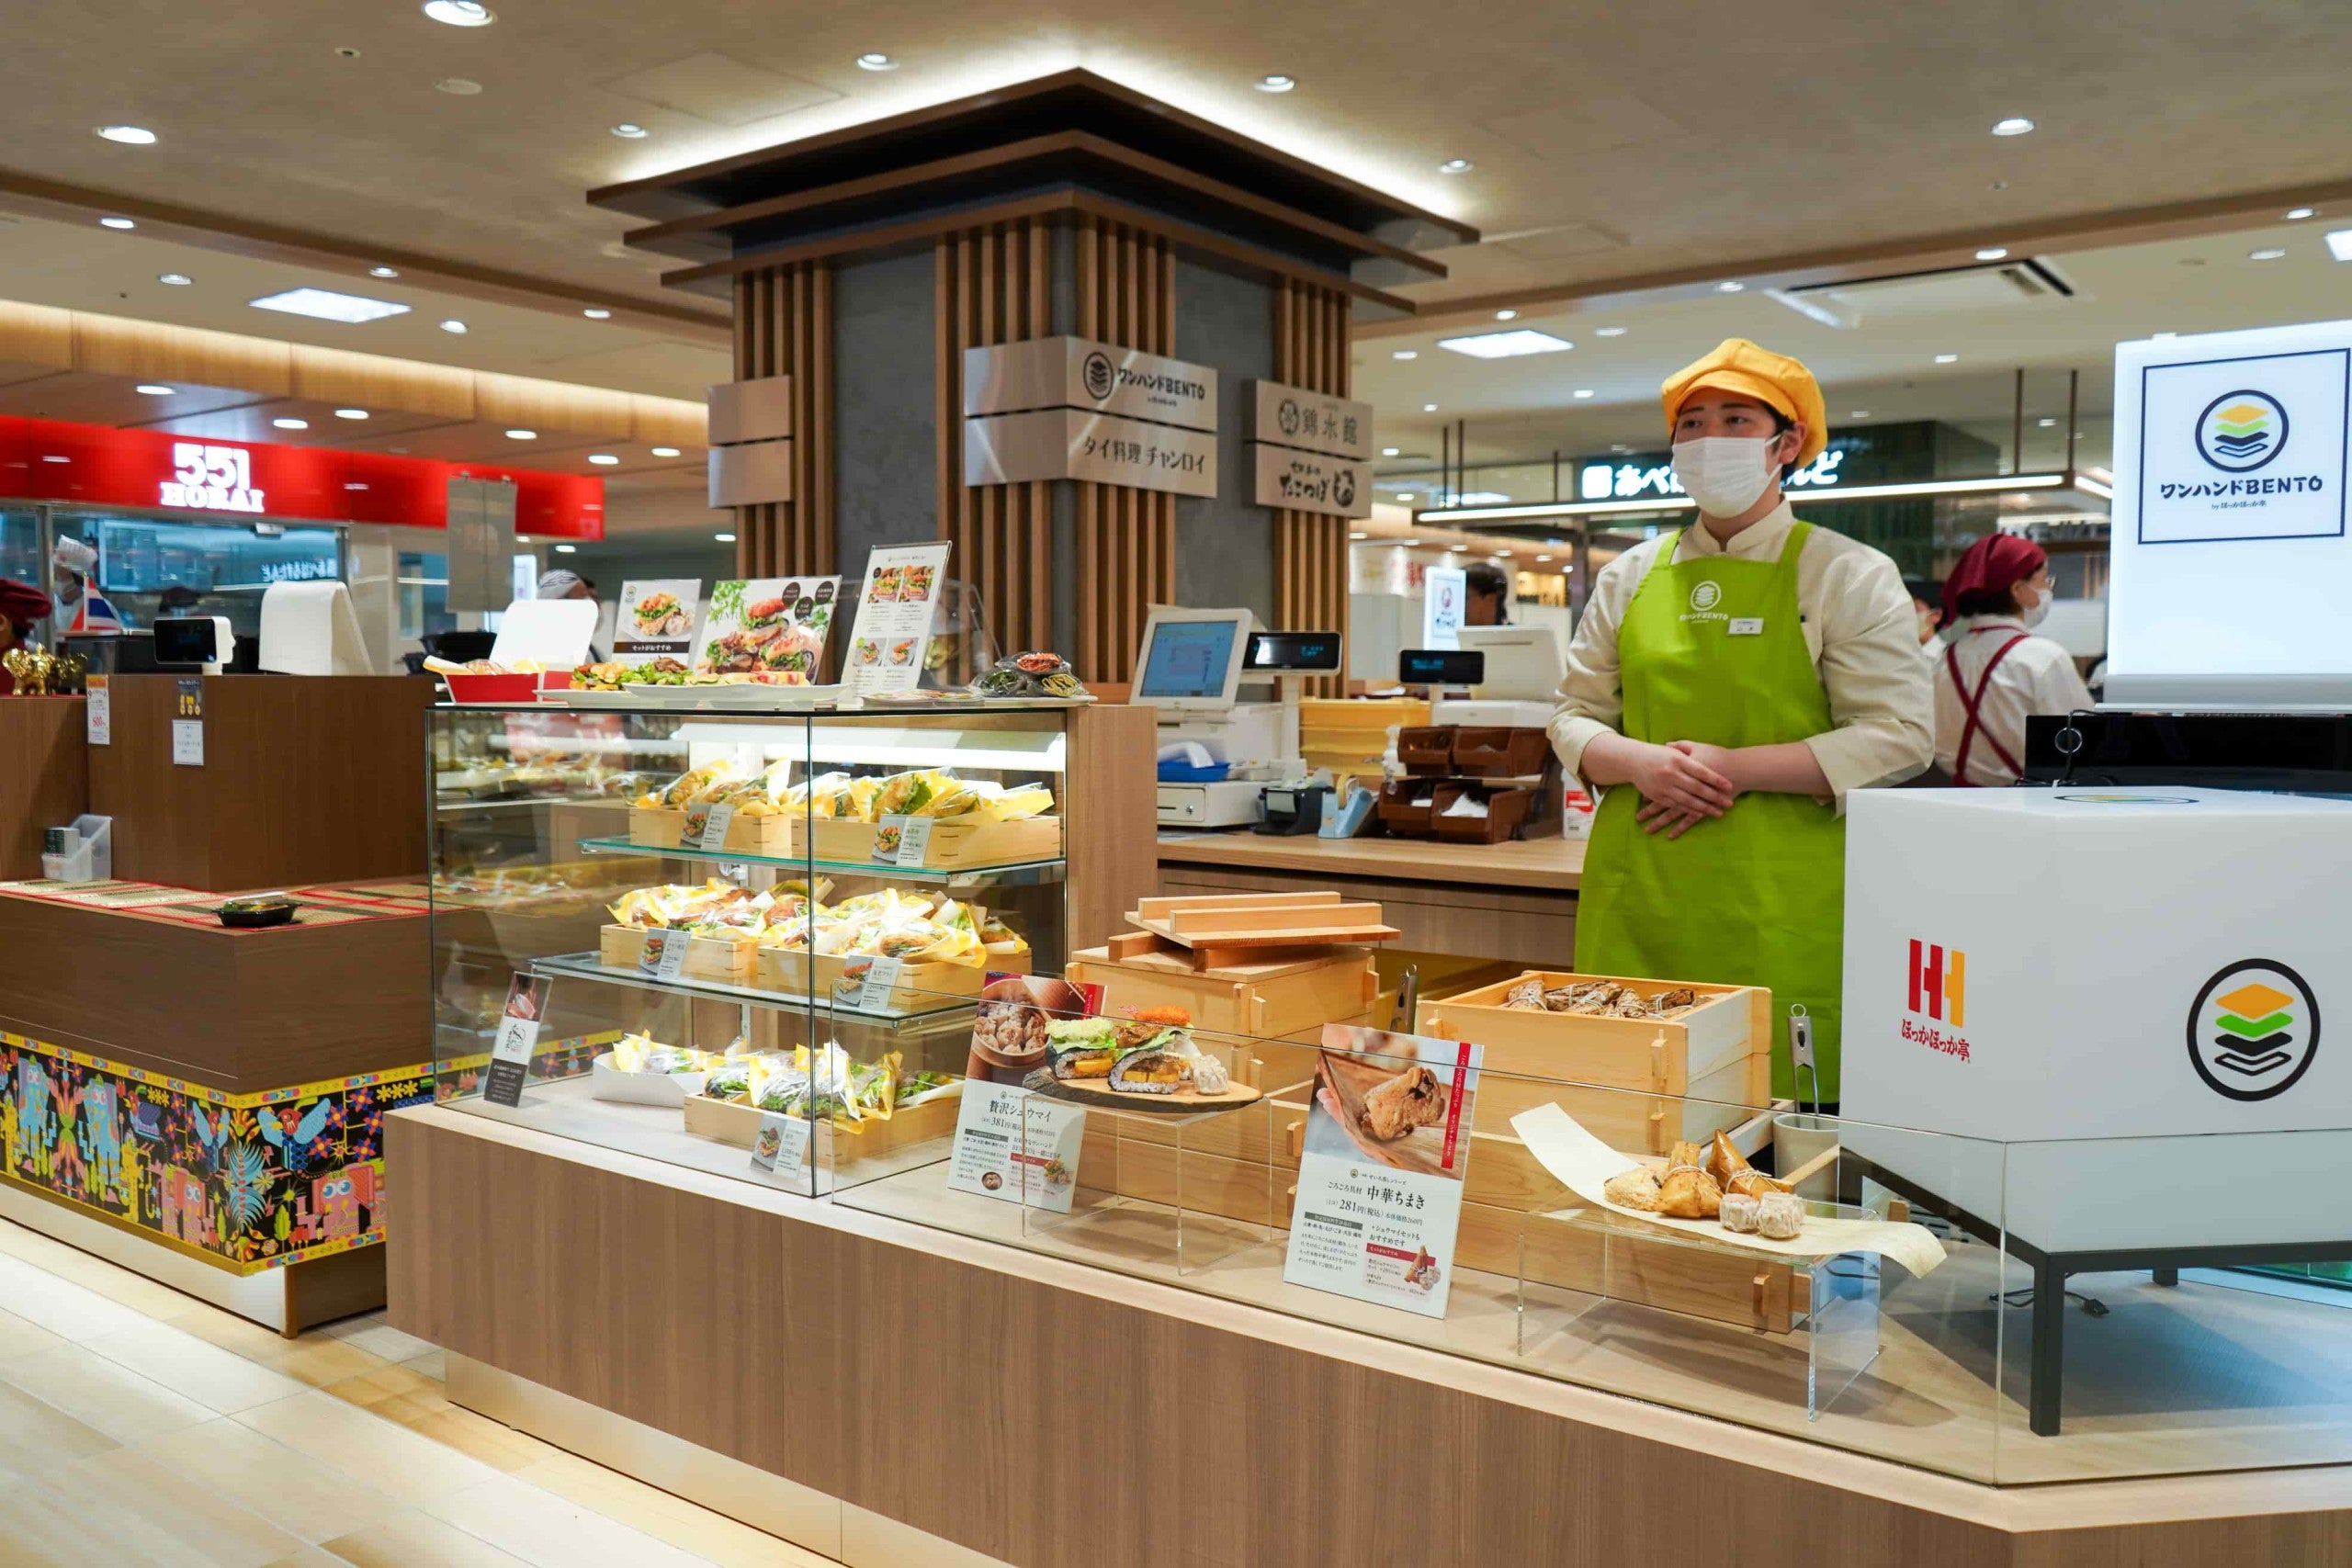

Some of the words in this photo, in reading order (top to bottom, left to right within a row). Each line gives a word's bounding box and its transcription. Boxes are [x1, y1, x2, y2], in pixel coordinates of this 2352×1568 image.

[1117, 367, 1205, 400] ワンハンドBENTO
[174, 443, 250, 490] 551
[1085, 436, 1141, 464] タイ料理
[1147, 446, 1204, 474] チャンロイ
[160, 482, 265, 513] HORAI
[2161, 475, 2323, 499] ワンハンドBENTO
[1902, 1018, 1970, 1062] ほっかほっか亭
[1328, 1181, 1363, 1194] ごろごろ具材
[1367, 1185, 1424, 1210] 中華ちまき
[1370, 1235, 1406, 1247] おすすめです
